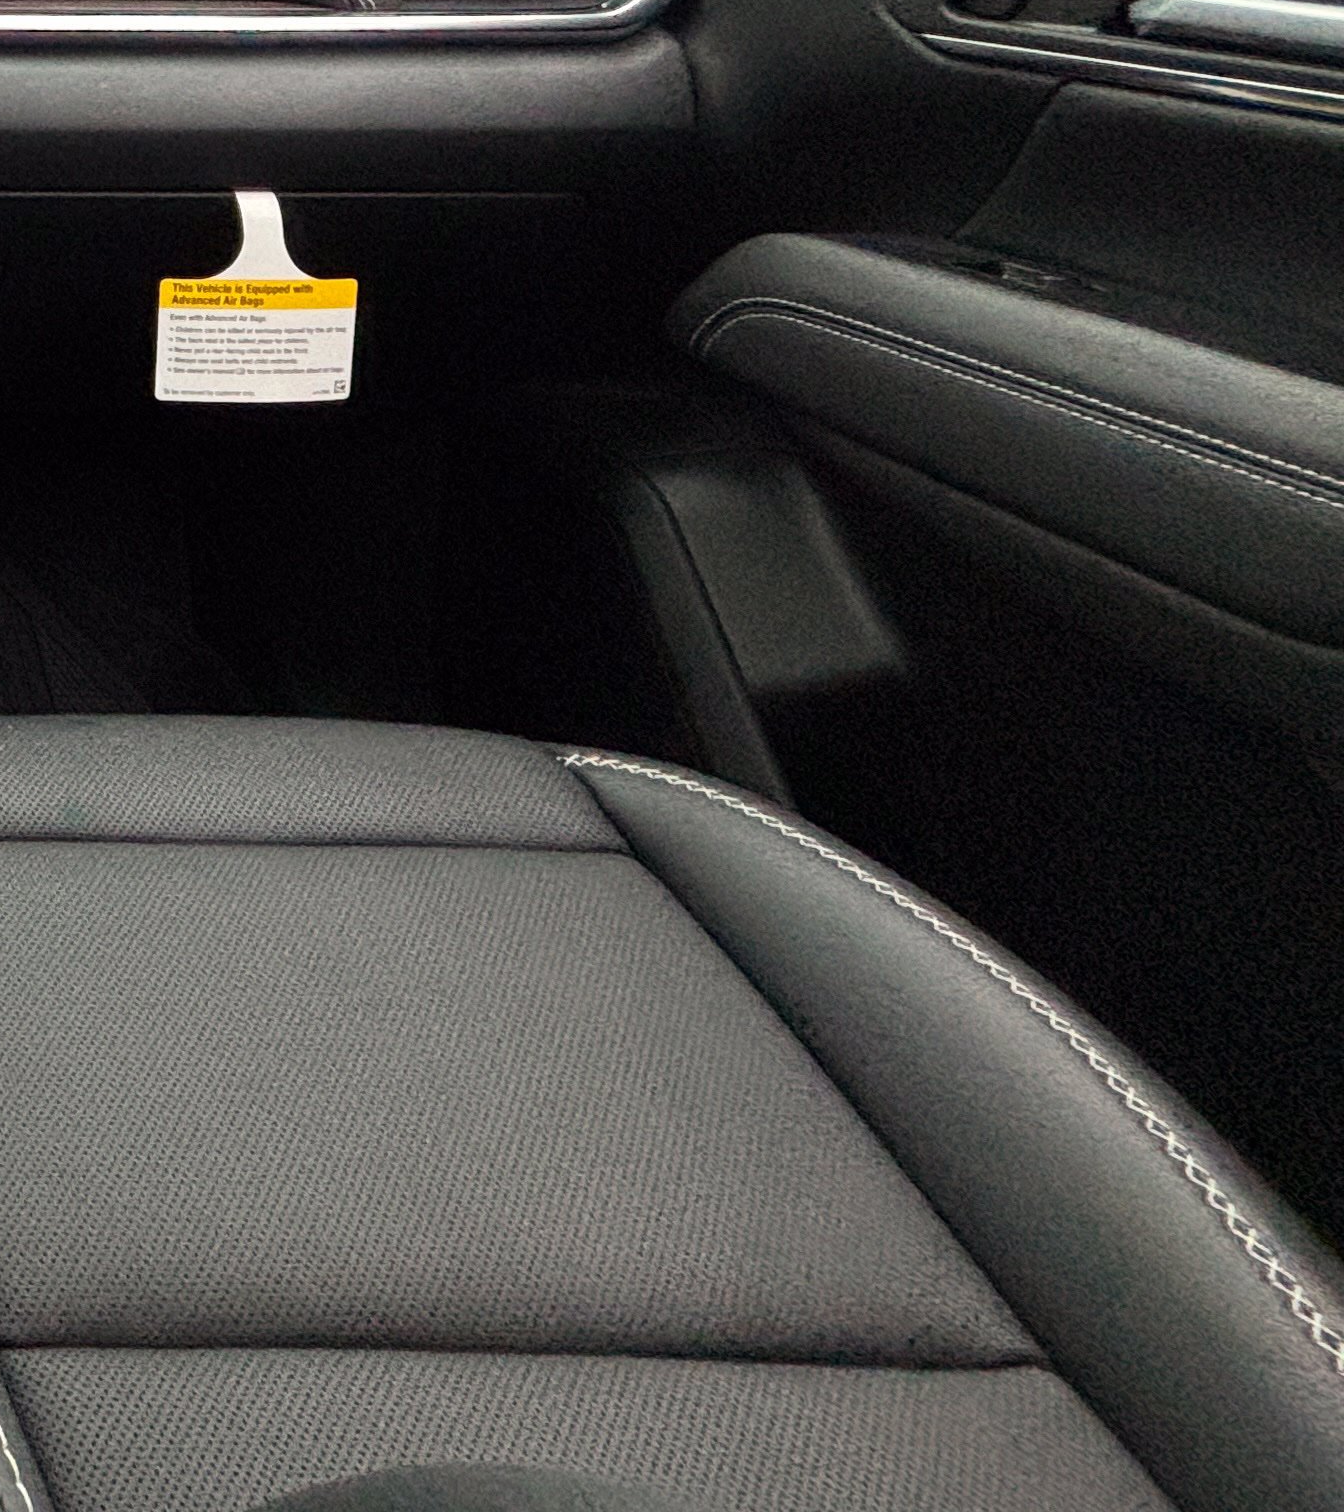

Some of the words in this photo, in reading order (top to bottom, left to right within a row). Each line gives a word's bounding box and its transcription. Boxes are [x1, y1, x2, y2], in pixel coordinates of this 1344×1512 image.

[173, 283, 193, 293] This
[196, 284, 232, 294] Vehicle
[235, 284, 243, 294] is
[246, 284, 290, 296] Equipped
[293, 284, 314, 294] with
[172, 295, 221, 306] Advanced
[223, 296, 238, 306] Air
[240, 296, 265, 307] Bags
